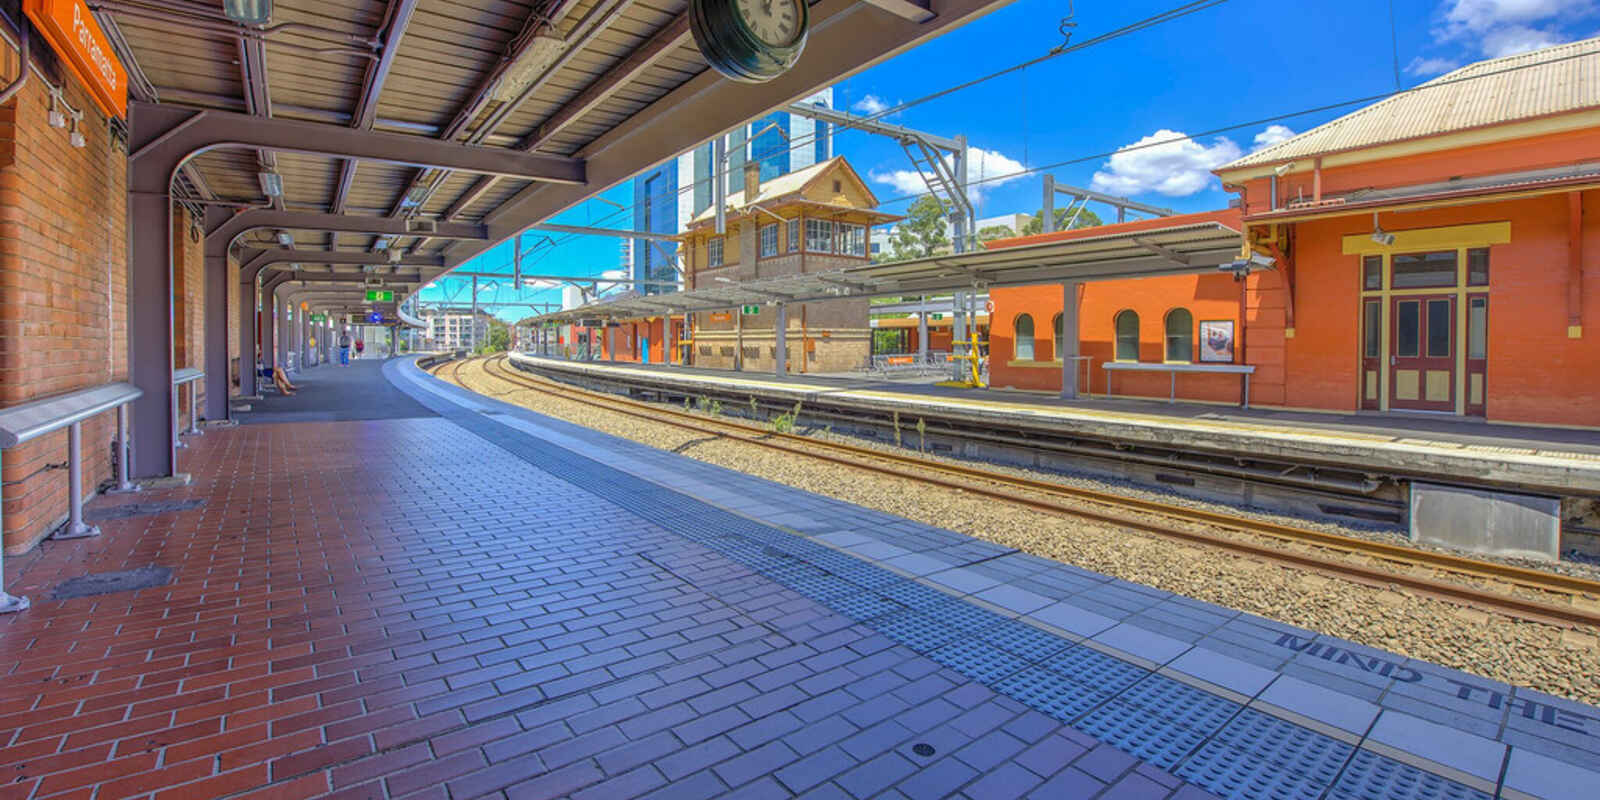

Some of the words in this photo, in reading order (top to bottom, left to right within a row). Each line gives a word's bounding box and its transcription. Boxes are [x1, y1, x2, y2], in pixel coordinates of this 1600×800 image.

[73, 2, 116, 91] Parramatta
[1274, 632, 1423, 684] MIND
[1446, 678, 1589, 735] THE
